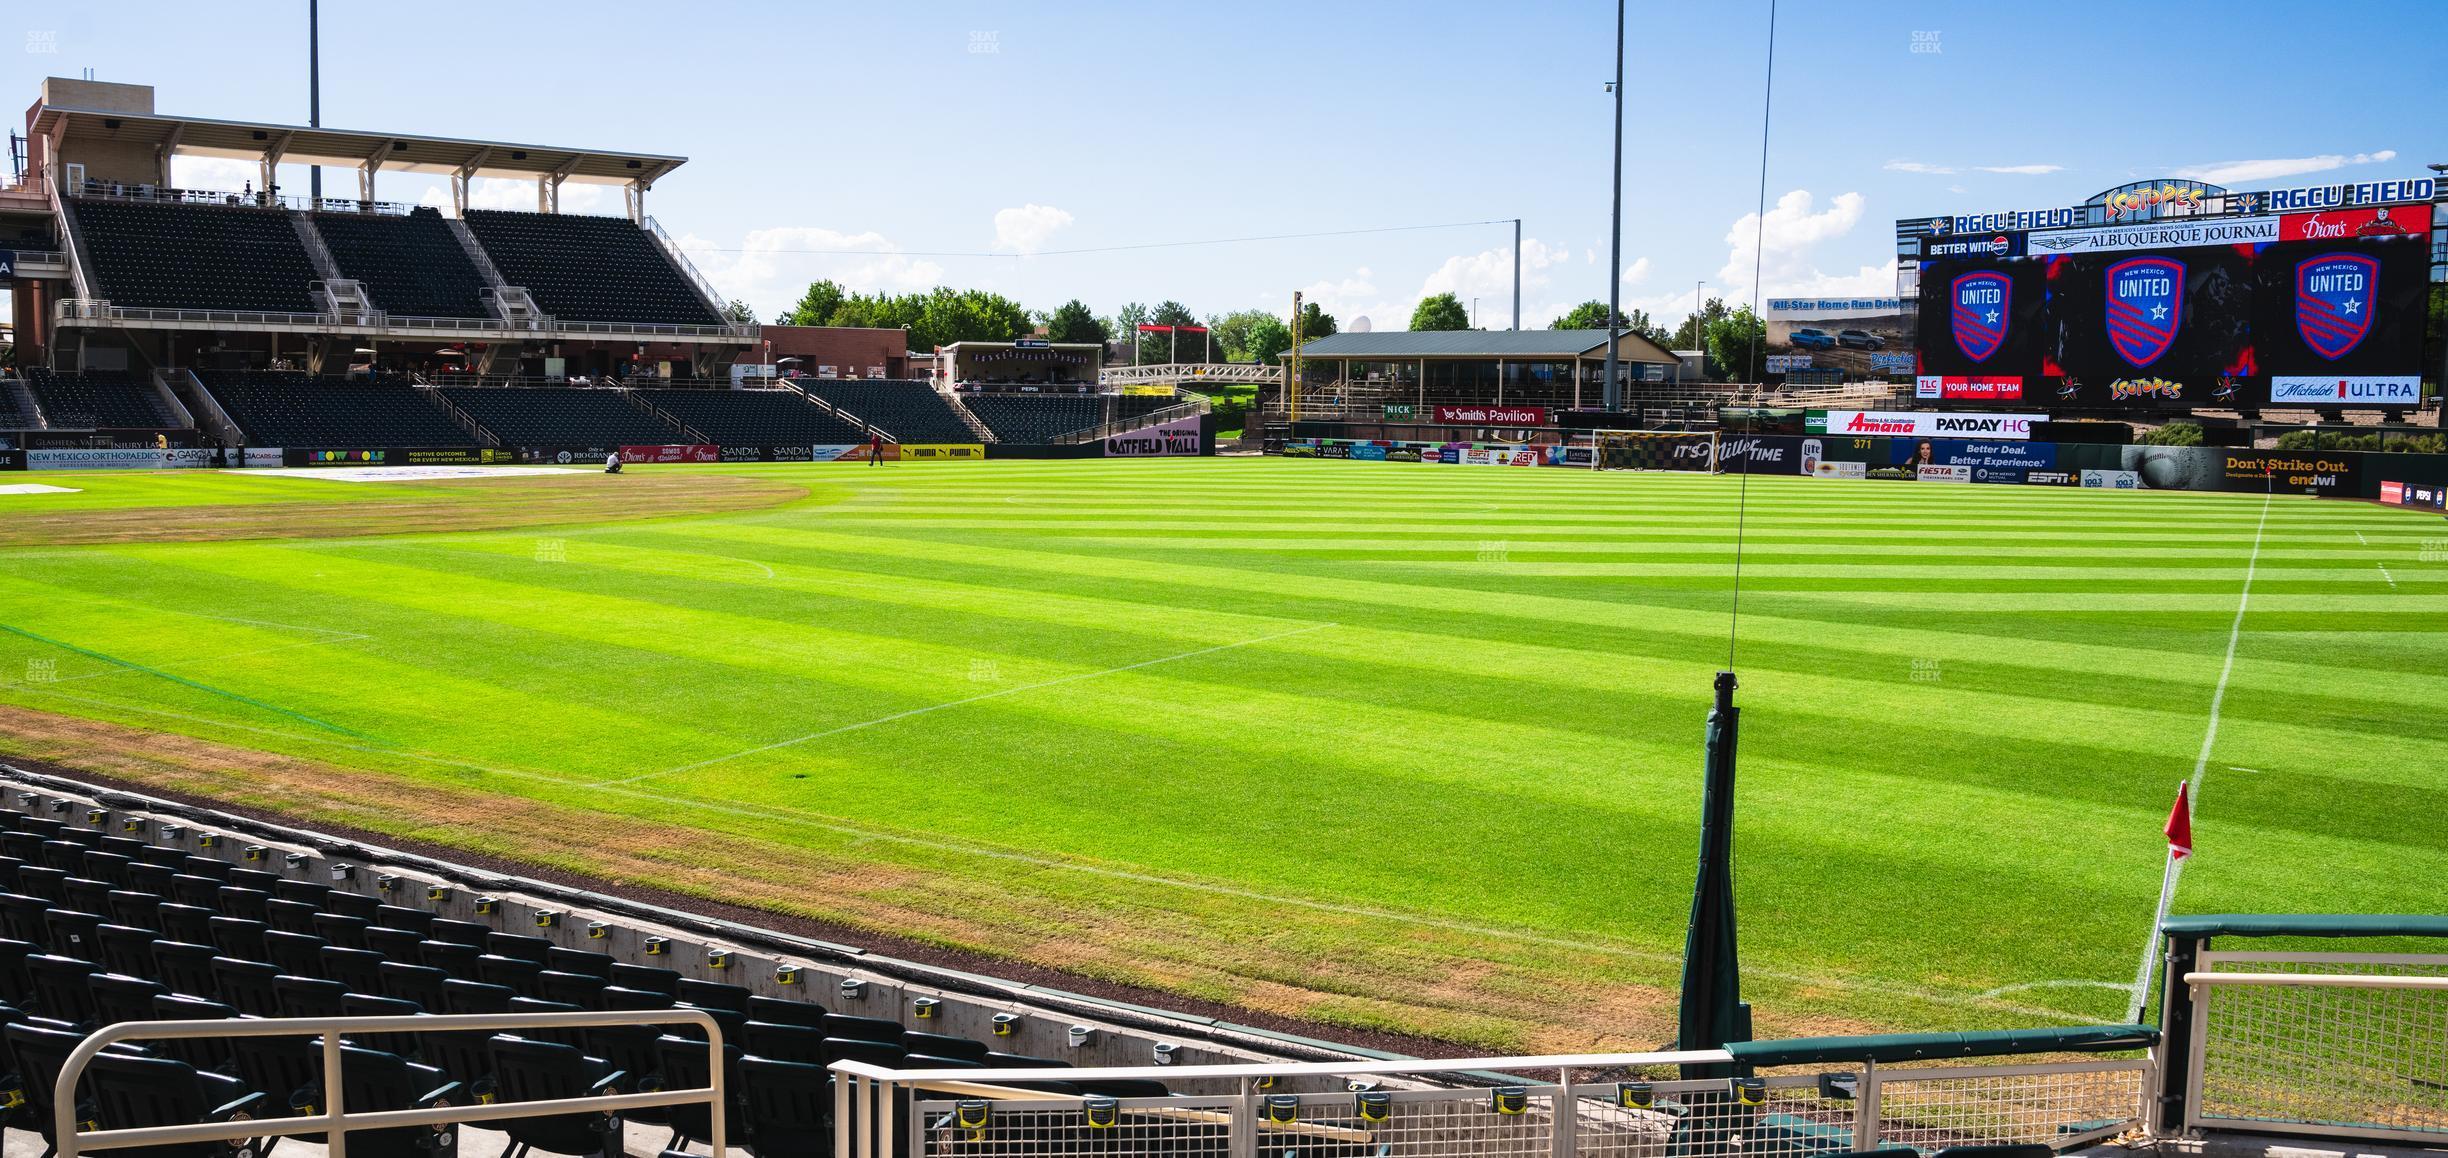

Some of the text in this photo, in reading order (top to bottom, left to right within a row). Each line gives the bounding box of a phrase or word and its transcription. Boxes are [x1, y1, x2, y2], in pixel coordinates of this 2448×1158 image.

[2270, 178, 2435, 211] RGCU FIELD
[2103, 182, 2205, 221] ISOTOPES
[1953, 207, 2074, 234] RGCU FIELD
[2302, 214, 2347, 240] Dion's
[2089, 224, 2278, 248] ALBUQUERQUE JOURNAL
[1930, 240, 1994, 256] BETTER WITH
[2124, 269, 2139, 277] NEW
[2316, 265, 2331, 273] NEW
[2120, 278, 2170, 298] UNITED
[2310, 274, 2363, 293] UNITED
[1962, 288, 2000, 305] UNITED
[1773, 300, 1815, 311] All-Star
[1818, 300, 1850, 311] Home
[1851, 300, 1872, 310] Run
[1920, 379, 1937, 389] TLC
[1946, 383, 2019, 392] YOUR HOME TEAM
[2109, 376, 2183, 400] ISOTOPES
[2276, 382, 2412, 397] Michelob ULTRA
[1387, 406, 1410, 414] NICK
[1456, 408, 1535, 422] Smith's Pavilion
[1847, 413, 1916, 433] Amana
[1936, 418, 2001, 432] PAYDAY
[1166, 438, 1198, 453] WALL
[1804, 444, 1820, 456] Lite
[1854, 439, 1872, 449] 371
[1966, 444, 2027, 455] Better Deal.
[92, 452, 160, 460] ORTHOPAEDICS
[622, 448, 646, 462] Dion's
[695, 448, 717, 462] Dion's
[722, 447, 761, 456] SANDIA
[773, 447, 812, 456] SANDIA
[914, 449, 936, 457] PUMA
[950, 449, 971, 457] PUMA
[1516, 452, 1534, 462] RED
[1674, 446, 1699, 459] IT'S
[1749, 448, 1784, 462] TIME
[1950, 456, 1982, 466] Better
[2226, 457, 2349, 473] Don't Strike Out.
[1919, 467, 1952, 475] FIESTA
[2289, 475, 2336, 486] endwi
[2416, 490, 2431, 501] PEPSI
